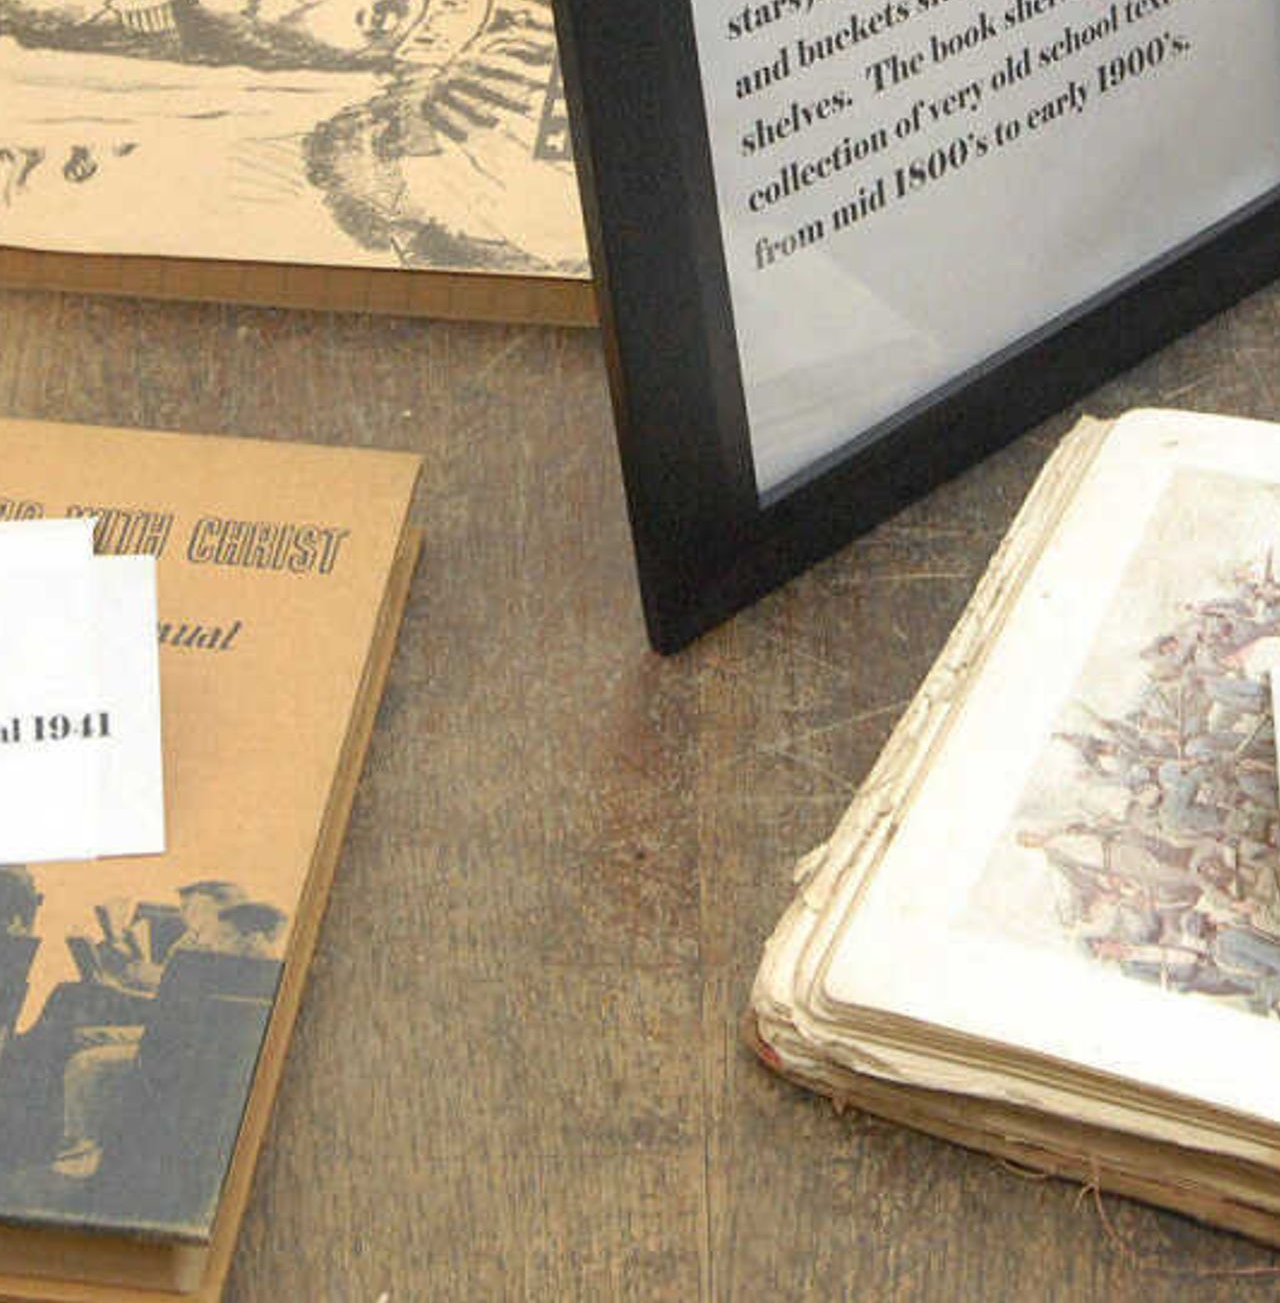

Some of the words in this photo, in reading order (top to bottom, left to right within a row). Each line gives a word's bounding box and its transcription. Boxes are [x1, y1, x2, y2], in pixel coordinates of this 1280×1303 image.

[734, 45, 791, 100] and
[795, 0, 910, 68] buckets
[740, 89, 854, 157] shelves.
[864, 50, 925, 94] The
[928, 10, 998, 64] book
[747, 127, 889, 213] collection
[892, 98, 925, 139] of
[926, 80, 982, 121] very
[989, 45, 1033, 92] old
[1037, 2, 1119, 69] school
[754, 218, 825, 270] from
[830, 176, 887, 232] mid
[893, 131, 989, 200] 1800's
[993, 118, 1021, 147] to
[1025, 80, 1088, 131] early
[1095, 30, 1191, 94] 1900's.
[186, 516, 351, 575] CHRIST
[156, 618, 244, 651] nual
[31, 710, 113, 742] 1941
